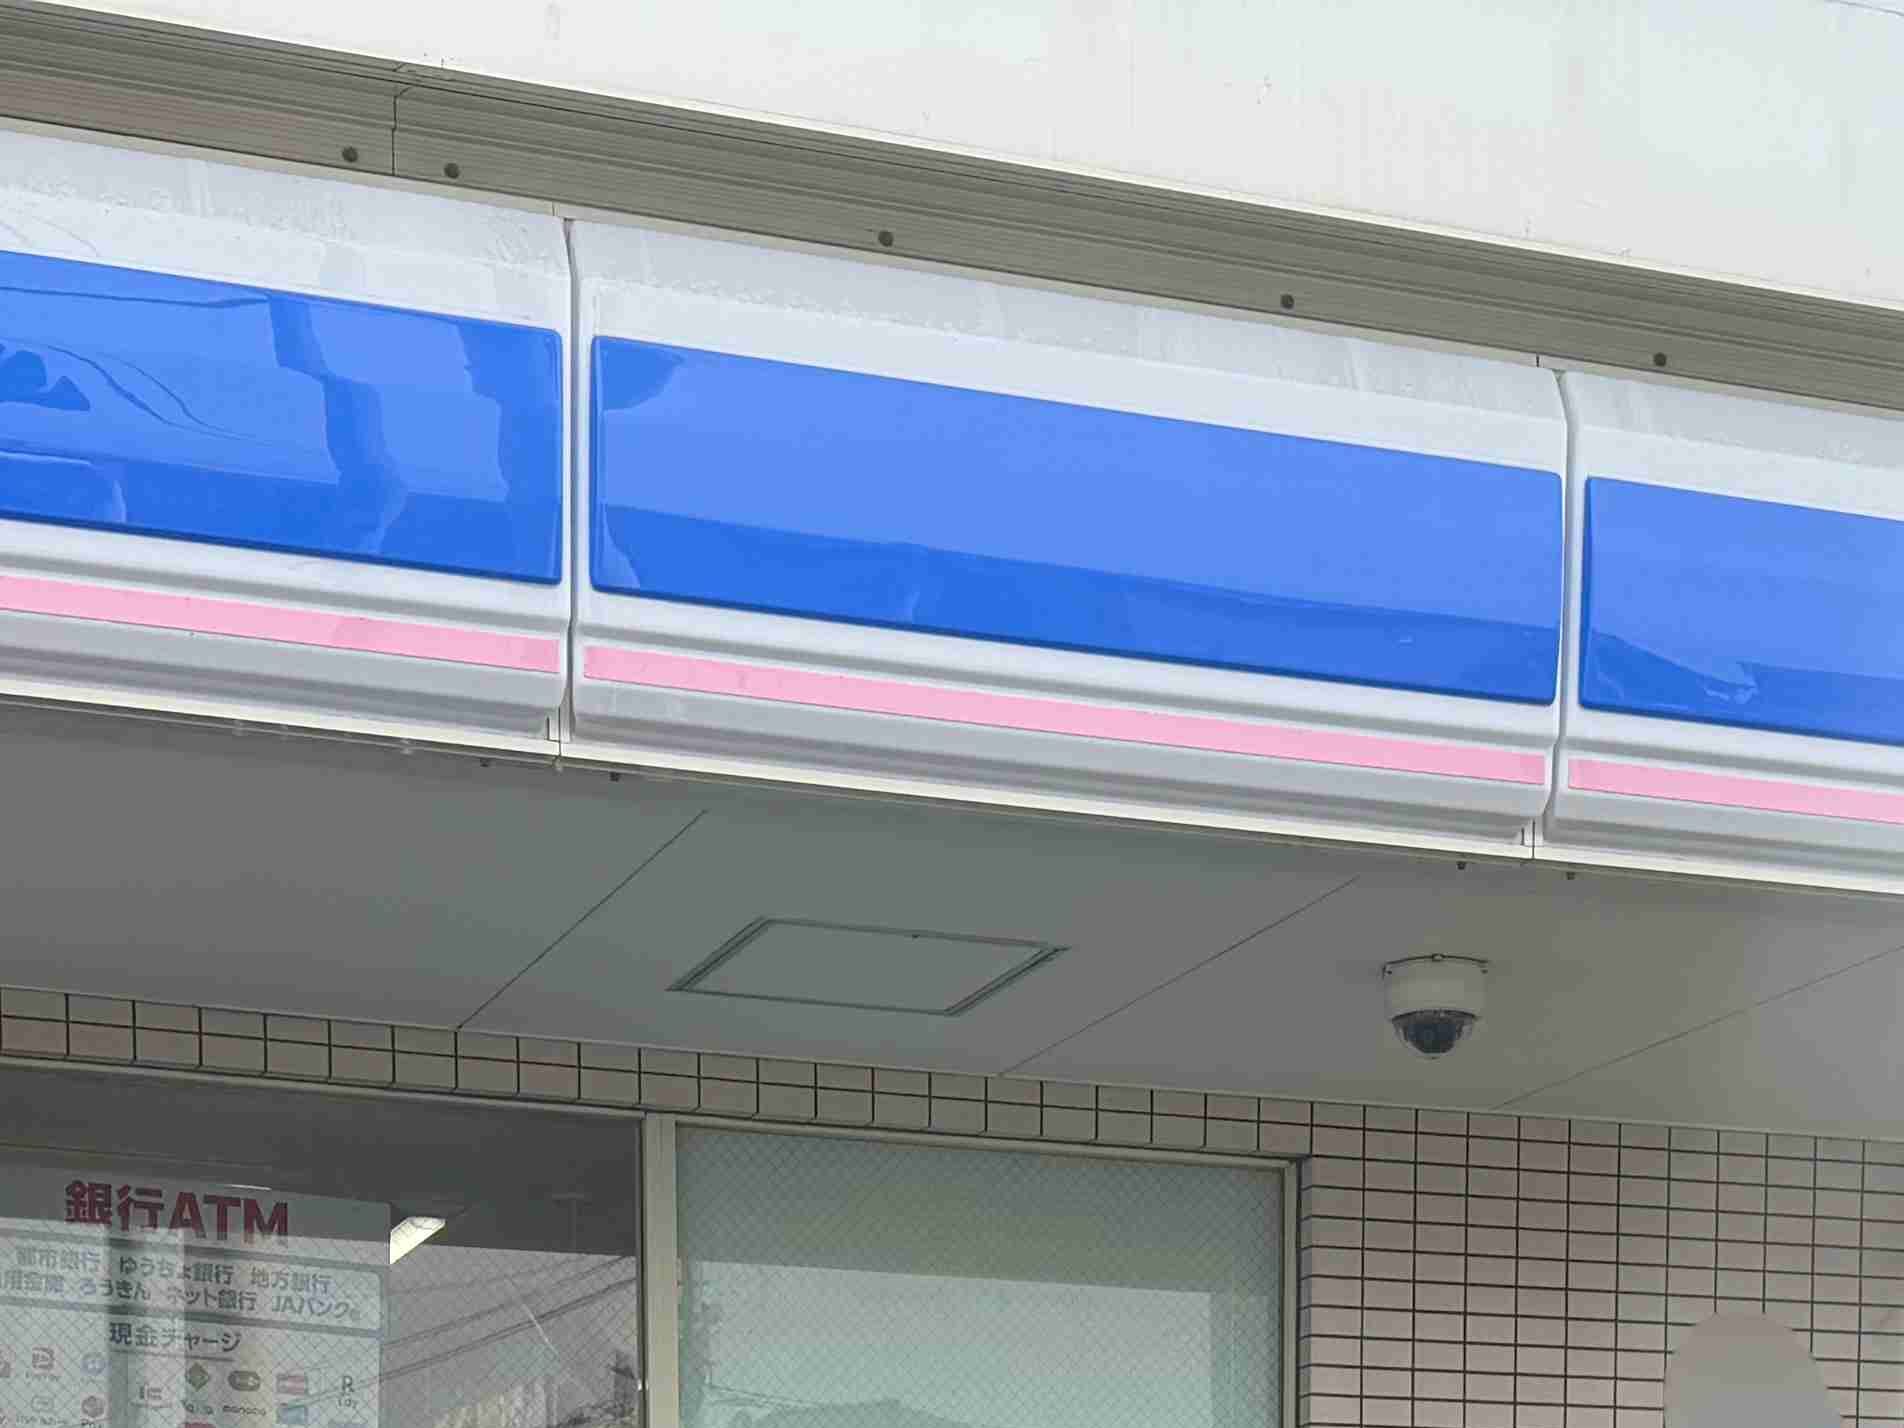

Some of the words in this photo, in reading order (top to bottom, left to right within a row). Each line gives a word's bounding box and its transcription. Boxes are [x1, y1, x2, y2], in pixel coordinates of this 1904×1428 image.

[64, 1180, 289, 1247] 銀行ATM
[108, 1320, 242, 1354] 現金チャージ
